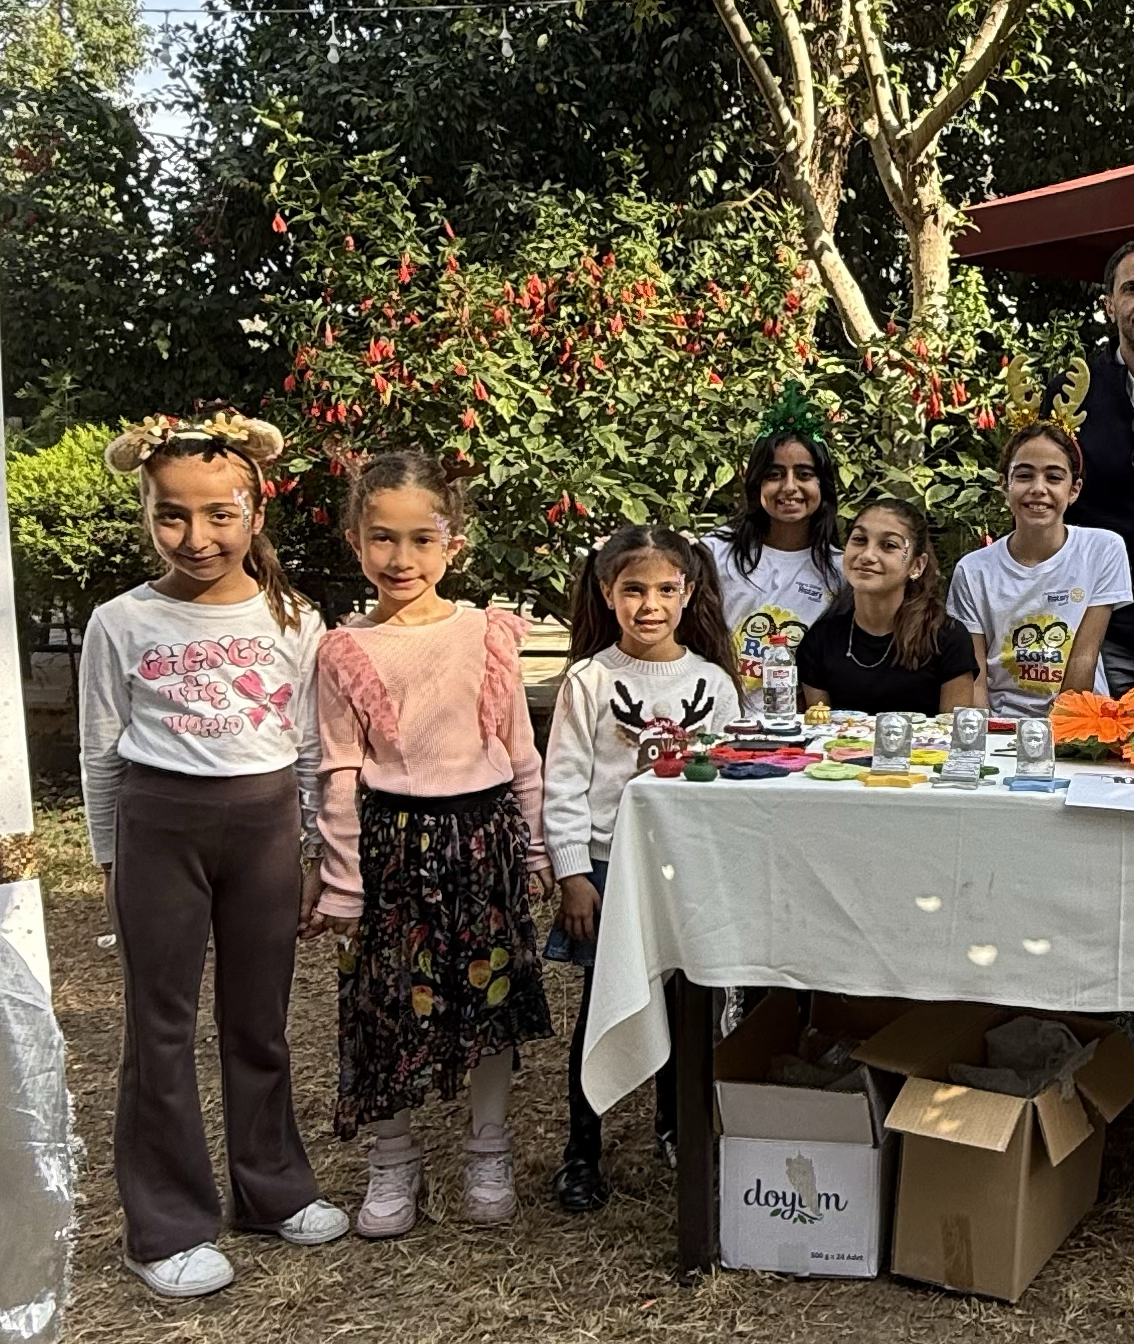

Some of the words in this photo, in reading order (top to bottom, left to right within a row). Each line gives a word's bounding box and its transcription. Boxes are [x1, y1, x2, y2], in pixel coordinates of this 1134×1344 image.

[138, 635, 275, 680] CHANGE
[1016, 648, 1063, 663] Rota
[1018, 663, 1062, 683] Kids
[158, 673, 230, 710] THE
[162, 714, 244, 738] WORLD
